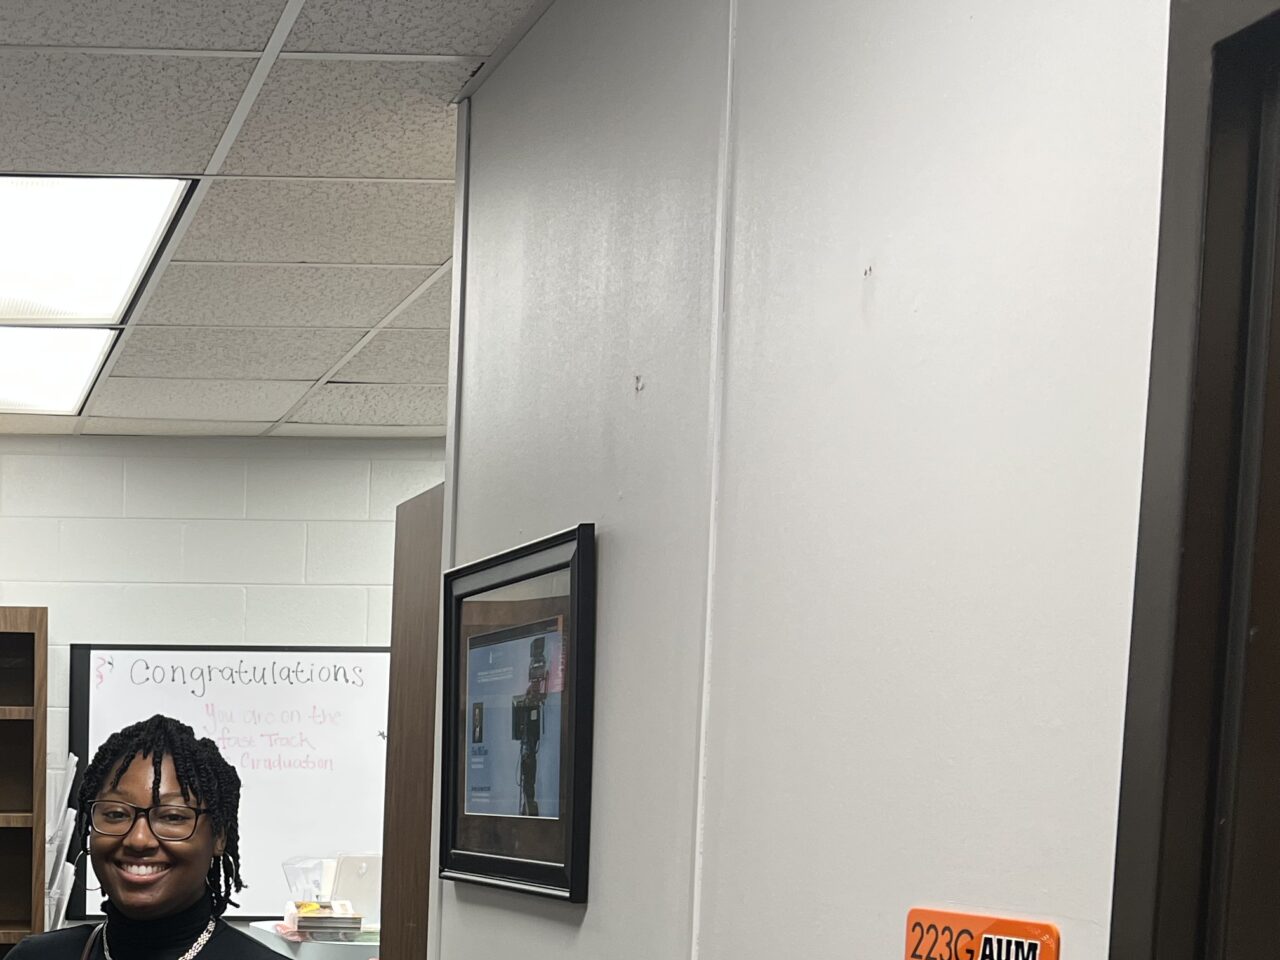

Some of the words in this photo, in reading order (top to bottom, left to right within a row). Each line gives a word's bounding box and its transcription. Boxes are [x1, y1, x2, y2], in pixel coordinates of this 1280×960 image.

[130, 658, 365, 698] Congratulations
[243, 709, 275, 725] are
[281, 709, 301, 724] on
[308, 704, 342, 725] the
[260, 732, 317, 750] Track
[241, 752, 334, 771] Graduation
